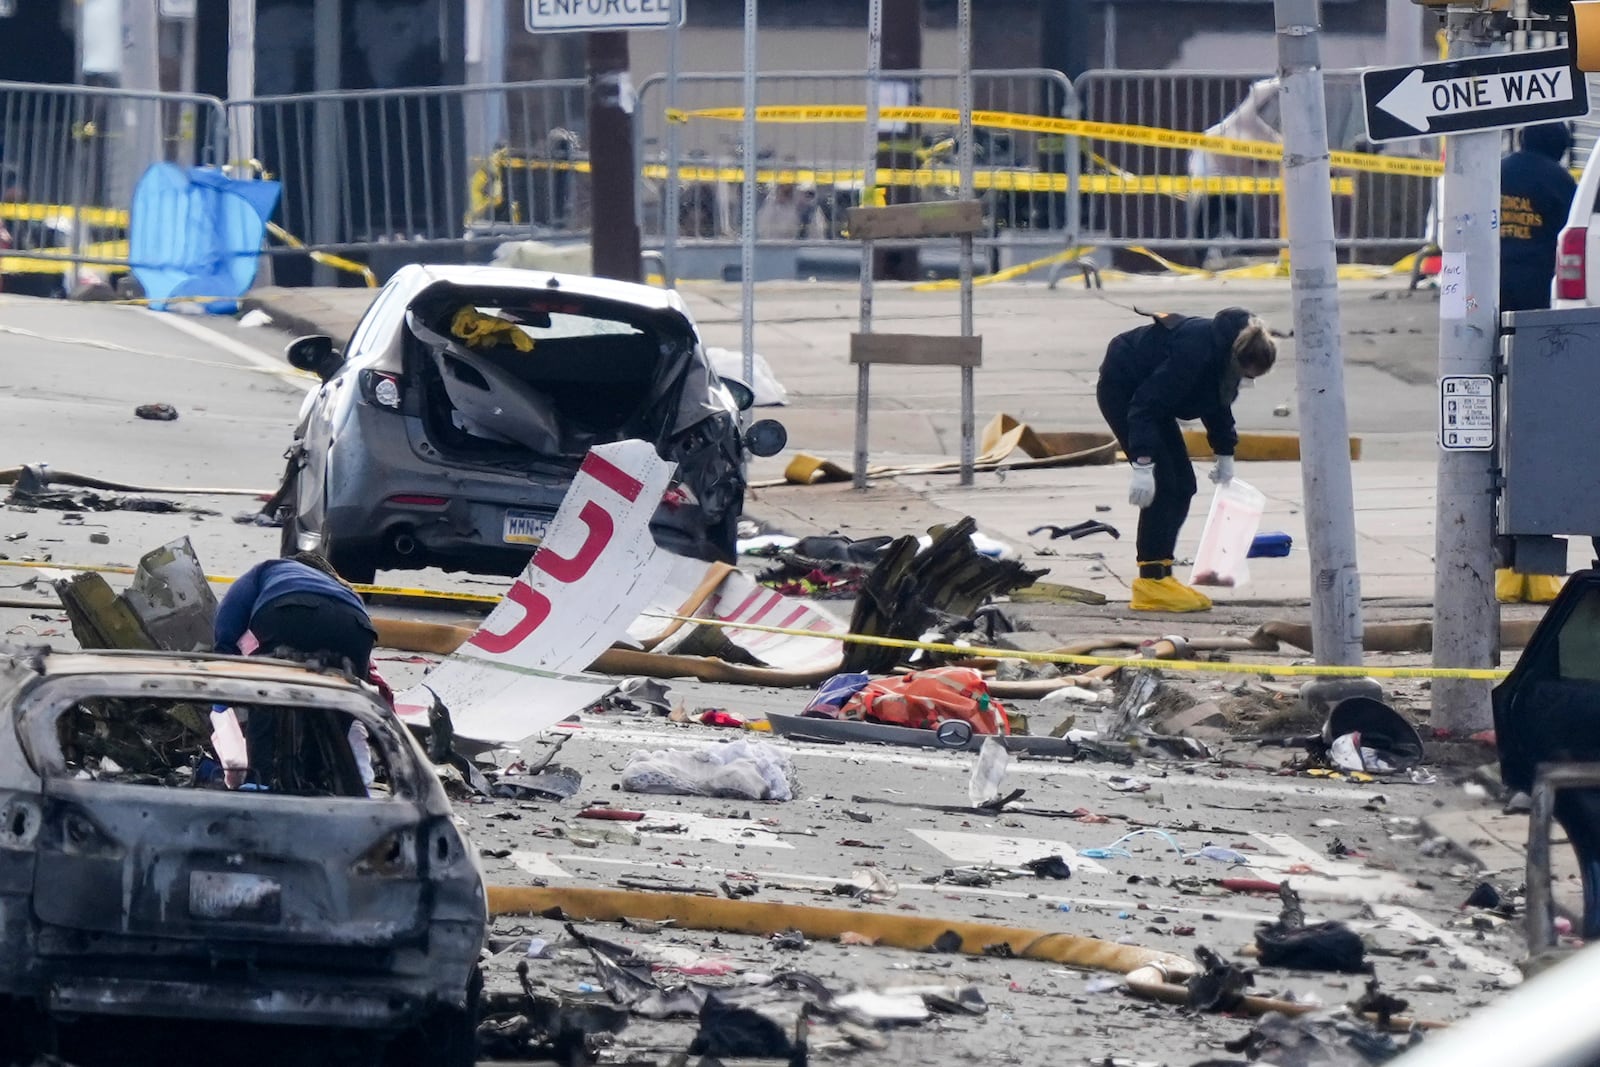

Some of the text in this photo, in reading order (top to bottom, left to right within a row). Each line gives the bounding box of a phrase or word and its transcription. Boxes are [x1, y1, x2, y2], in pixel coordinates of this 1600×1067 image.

[1432, 70, 1561, 111] ONE WAY
[1501, 195, 1533, 211] DICAL
